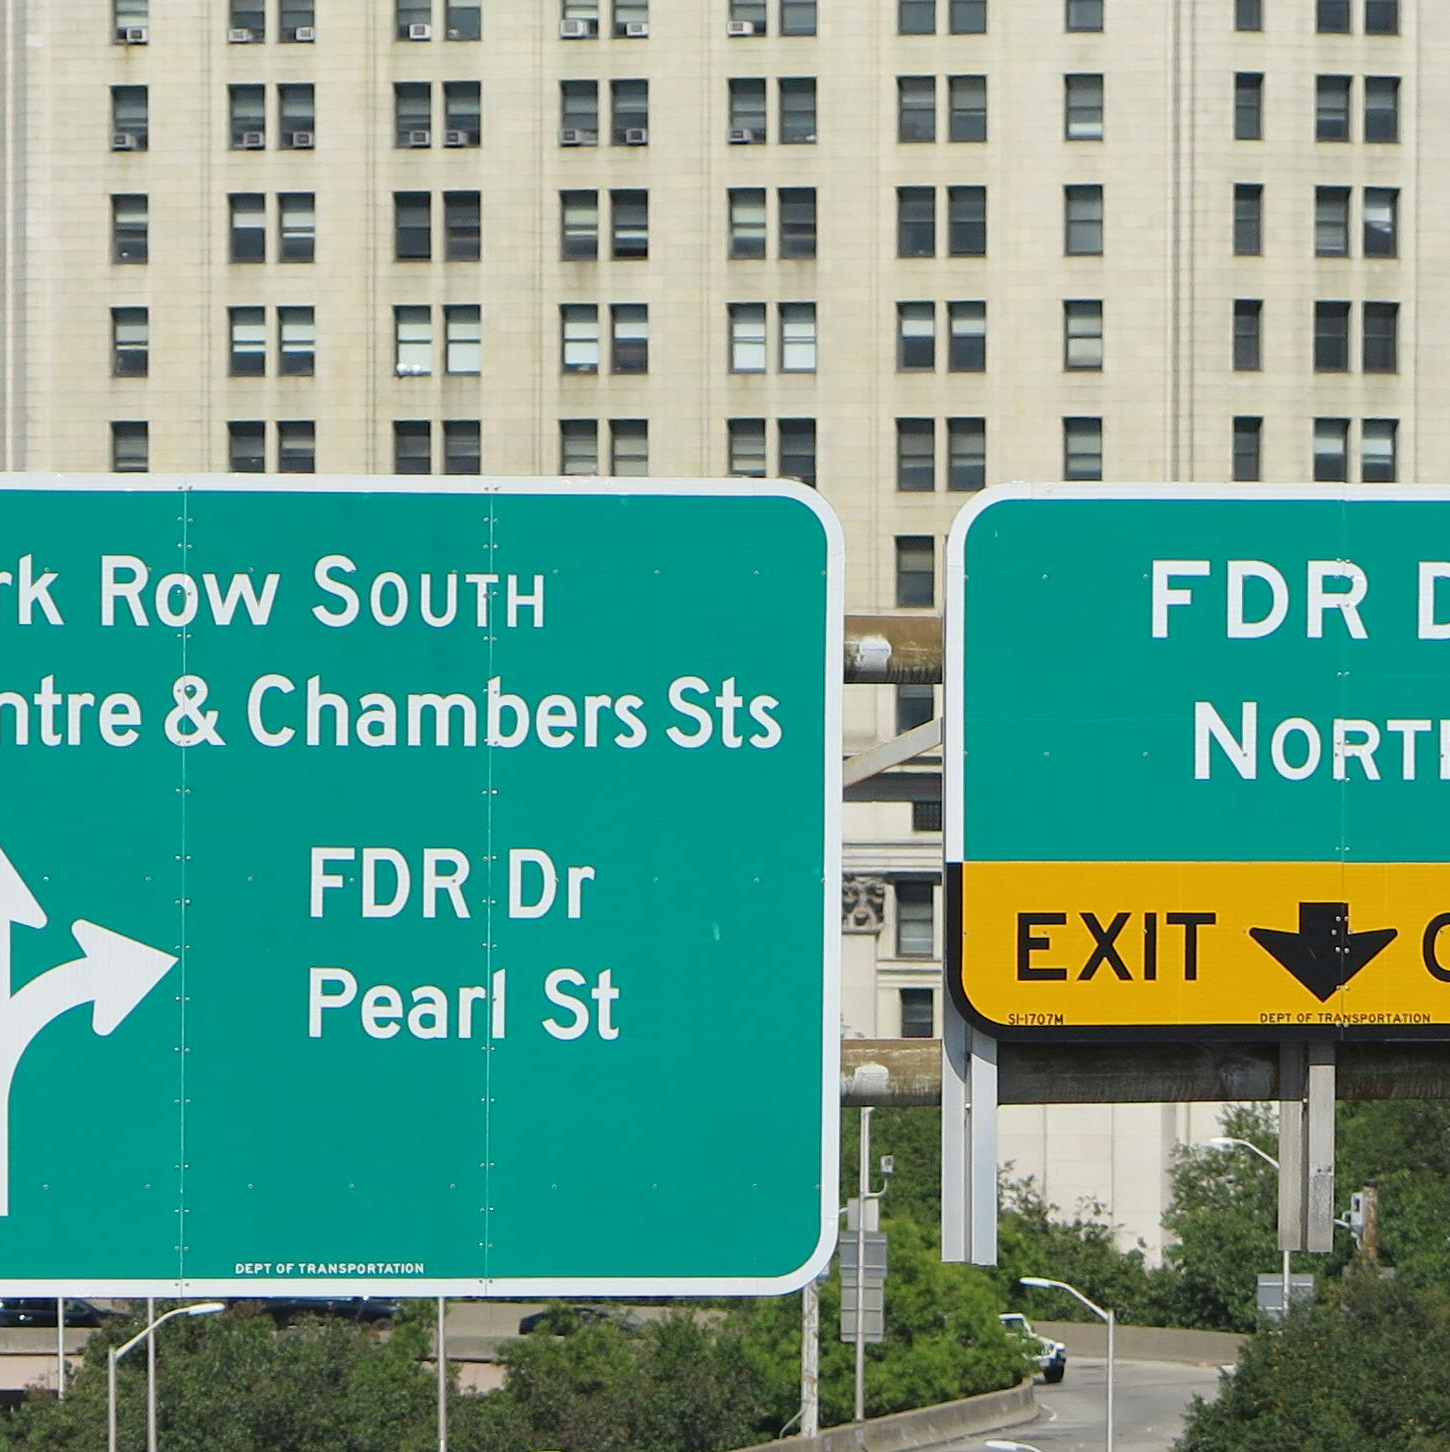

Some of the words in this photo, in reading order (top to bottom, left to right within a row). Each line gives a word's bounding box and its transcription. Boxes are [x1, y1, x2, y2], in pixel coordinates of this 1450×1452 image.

[101, 554, 281, 628] Row
[311, 554, 544, 628] SOUTH
[1152, 558, 1368, 640] FDR
[164, 674, 226, 747] &
[247, 673, 648, 749] Chambers
[666, 675, 782, 749] Sts
[310, 846, 471, 919] FDR
[509, 848, 596, 919] Dr
[1017, 912, 1216, 981] EXIT
[309, 967, 506, 1040] Pearl
[542, 968, 620, 1040] St
[1260, 1013, 1291, 1024] DEPT
[1296, 1013, 1313, 1024] OF
[1317, 1013, 1431, 1024] TRANSPORTATION
[235, 1263, 272, 1275] DEPT
[276, 1263, 295, 1275] OF
[299, 1263, 425, 1275] TRANSPORTATION
